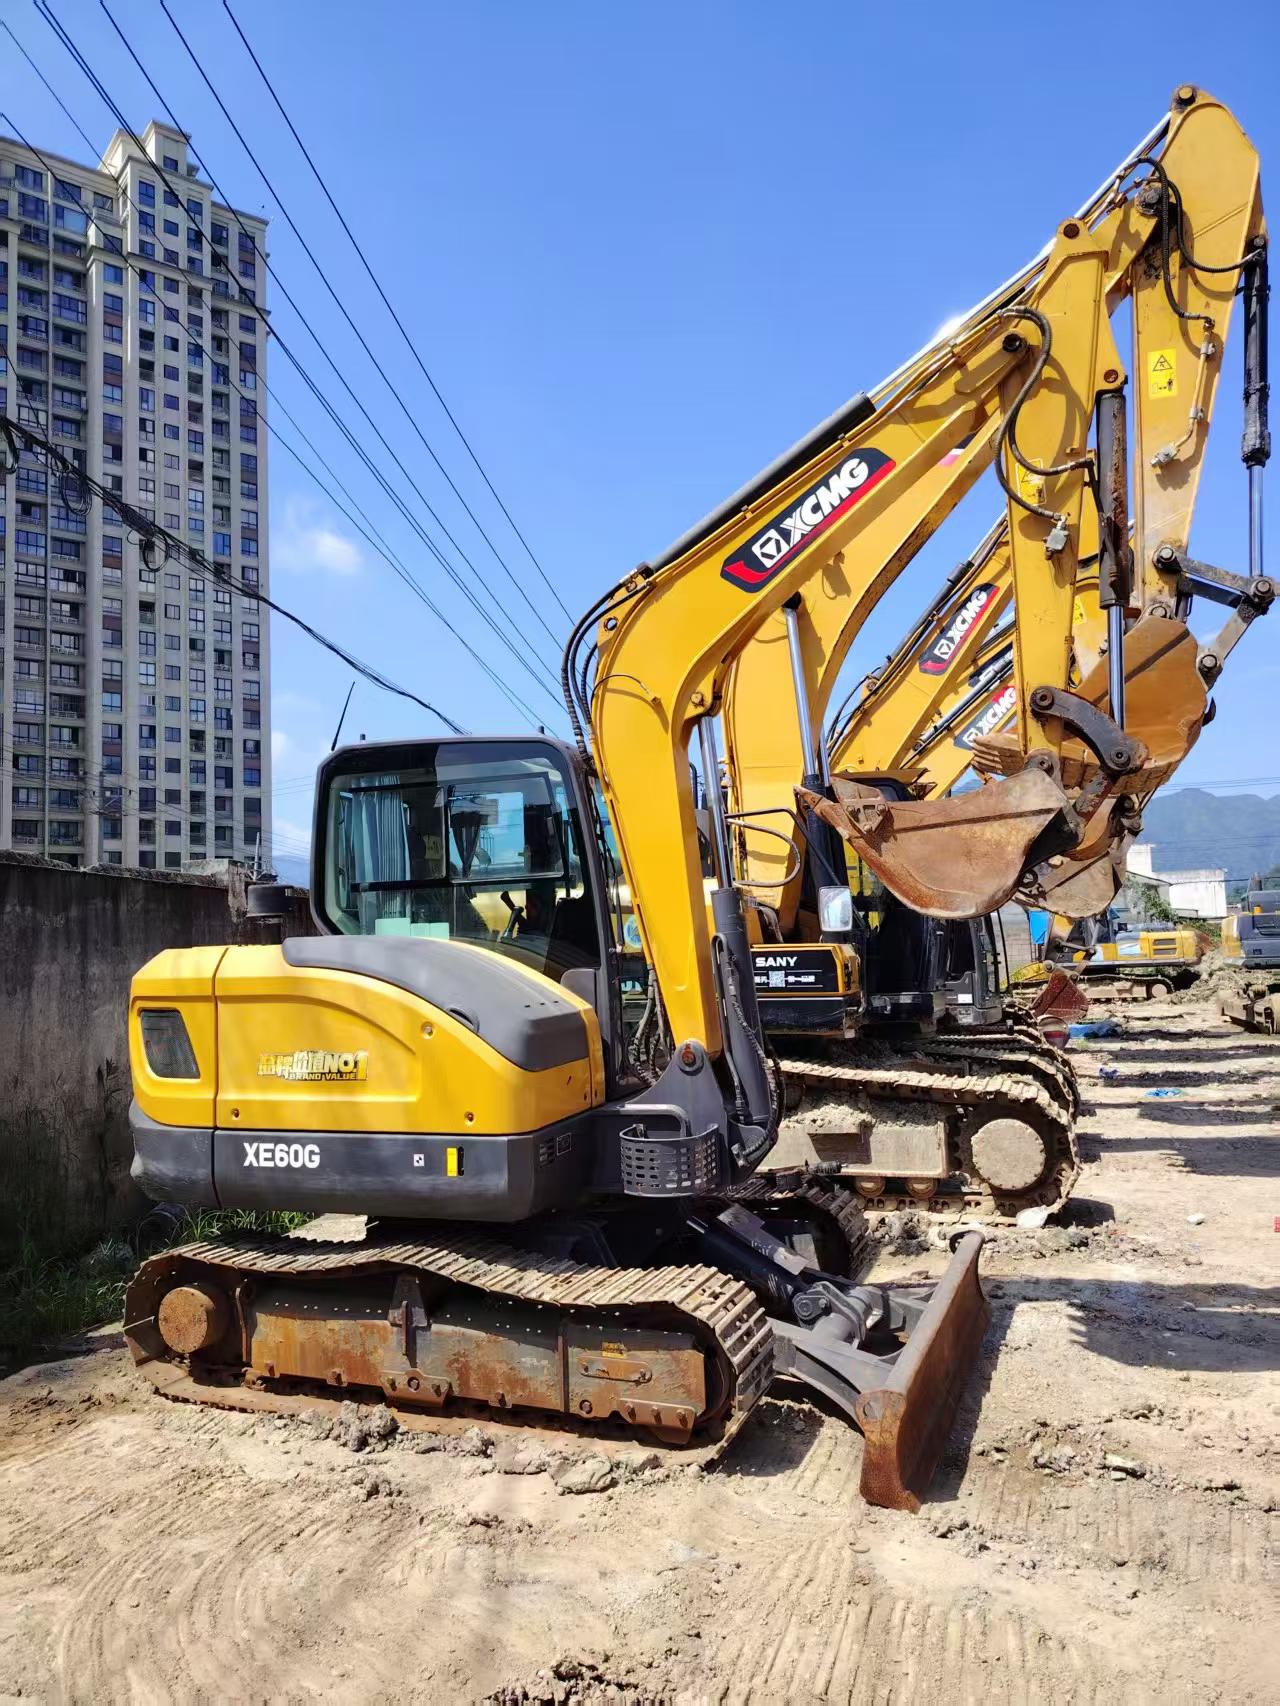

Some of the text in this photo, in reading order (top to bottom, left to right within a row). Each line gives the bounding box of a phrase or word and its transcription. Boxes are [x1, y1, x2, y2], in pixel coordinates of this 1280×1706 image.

[780, 458, 869, 547] XCMG
[947, 590, 987, 640] XCMG
[755, 956, 798, 967] SANY
[289, 1072, 357, 1081] BRAND VALUE
[243, 1142, 321, 1169] XE60G
